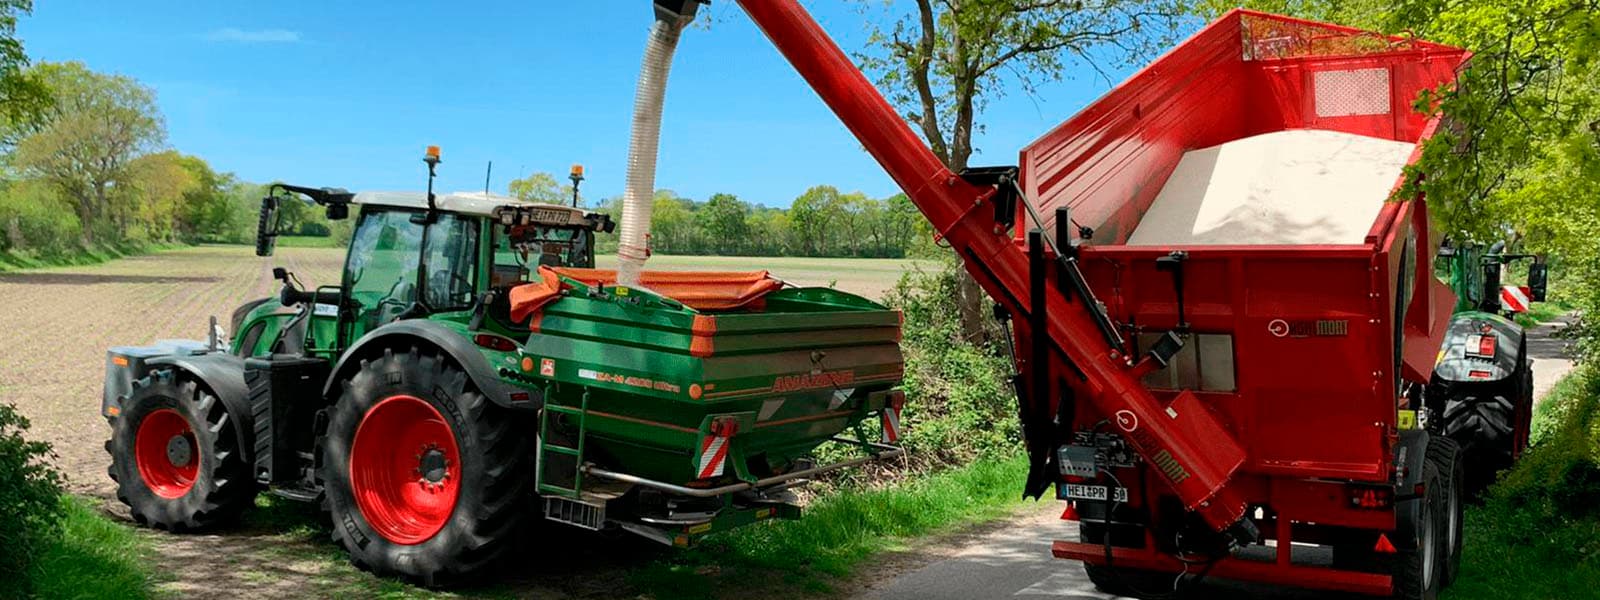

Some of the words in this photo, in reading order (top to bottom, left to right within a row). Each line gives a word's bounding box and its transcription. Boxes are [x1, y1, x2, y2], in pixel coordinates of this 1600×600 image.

[772, 370, 854, 392] AMAZONE
[1067, 485, 1087, 498] HEI
[1092, 487, 1106, 499] PR
